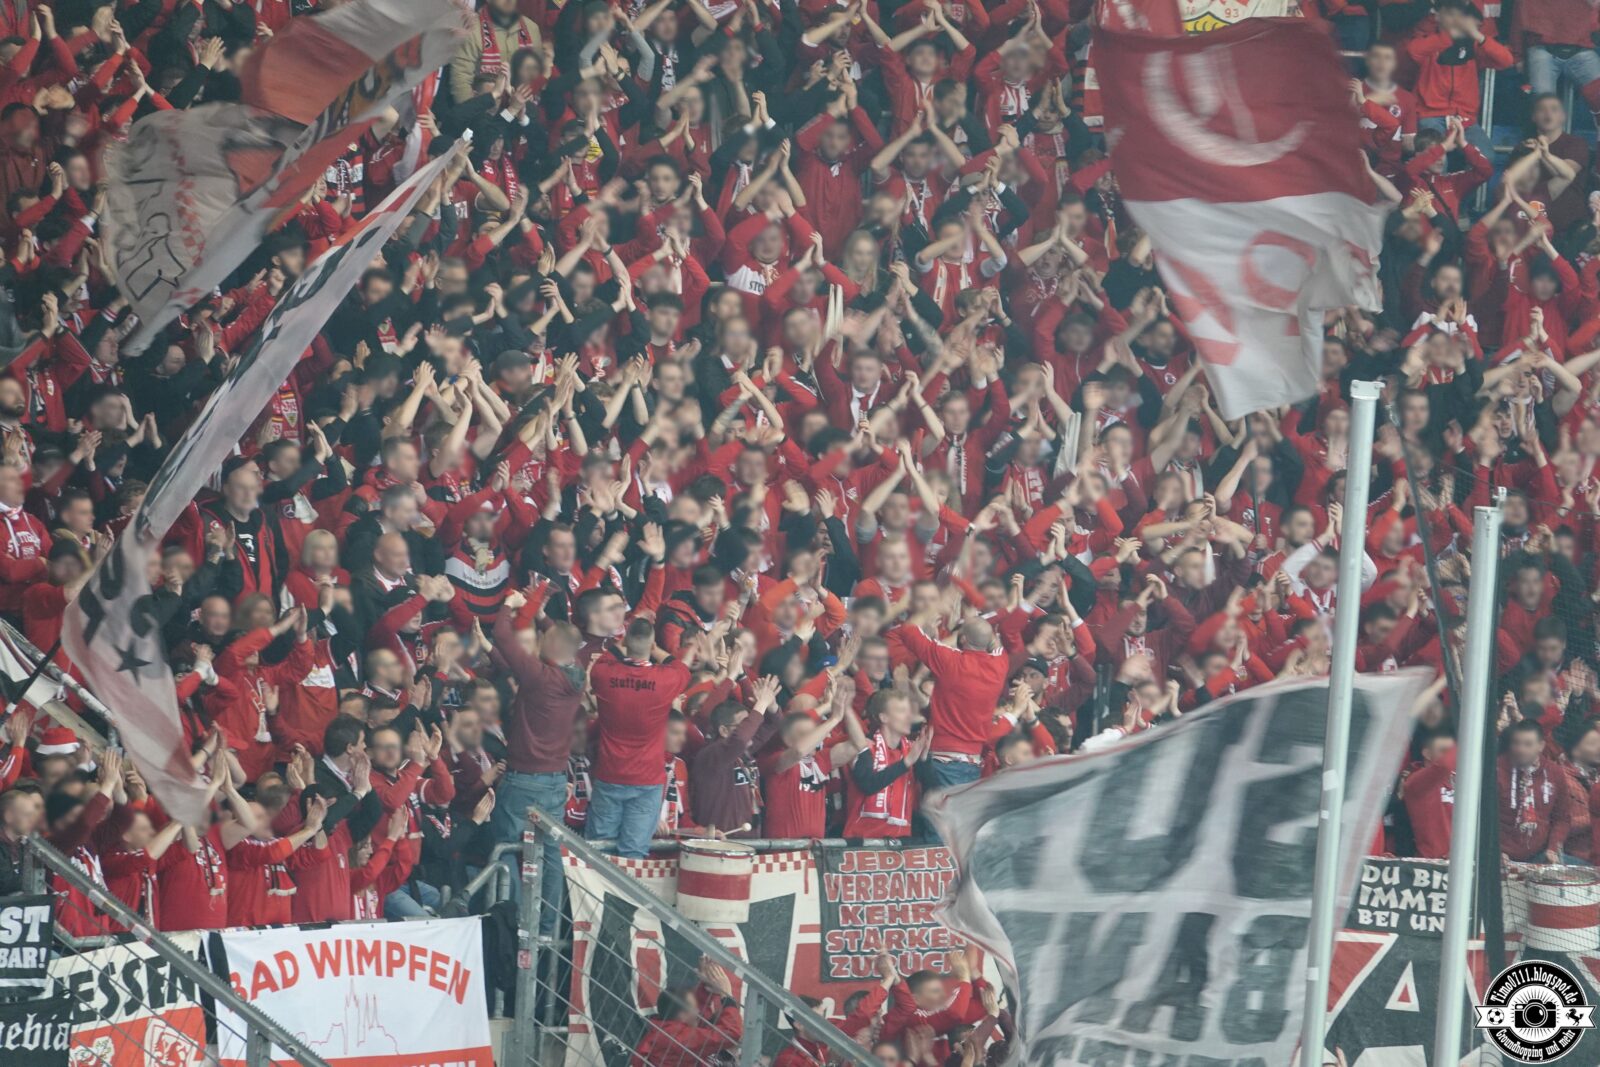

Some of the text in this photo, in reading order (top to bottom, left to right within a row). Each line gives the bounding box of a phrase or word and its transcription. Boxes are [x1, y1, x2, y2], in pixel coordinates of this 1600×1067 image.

[838, 847, 957, 872] JEDER
[824, 870, 954, 902] VERBANNT
[1361, 864, 1400, 885] DU
[1359, 884, 1447, 914] IMME
[839, 901, 937, 926] KEHR
[1357, 908, 1446, 932] BEI UN
[229, 939, 471, 1012] BAD WIMPFEN
